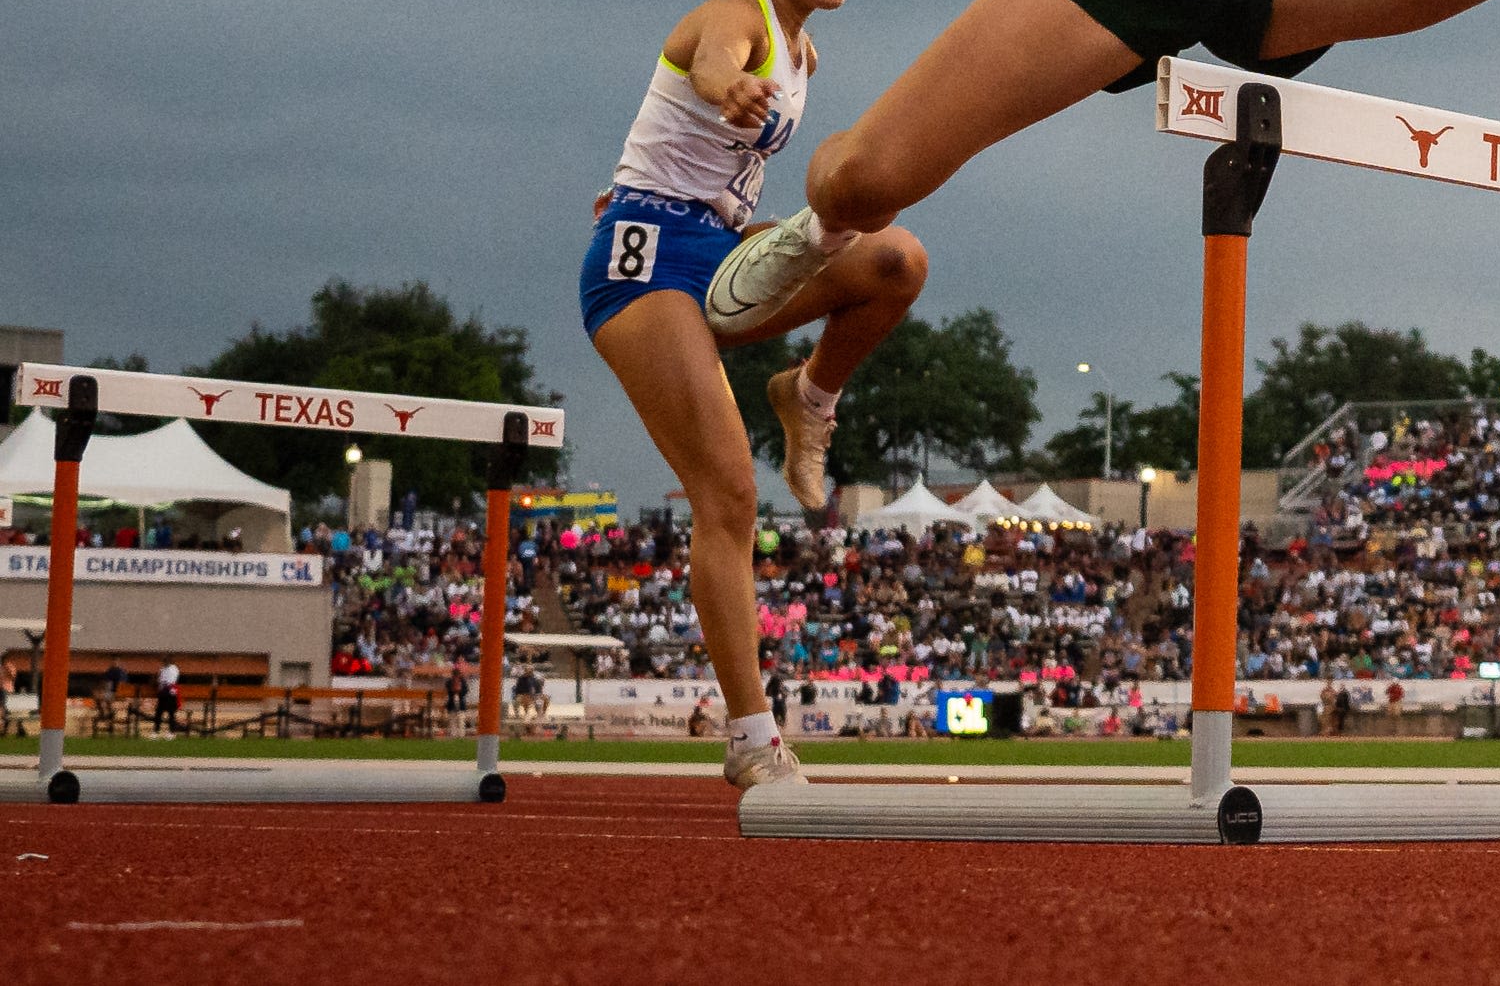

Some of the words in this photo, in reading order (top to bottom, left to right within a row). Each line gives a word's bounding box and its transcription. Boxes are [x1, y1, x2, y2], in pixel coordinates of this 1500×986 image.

[1181, 84, 1224, 123] XII
[617, 225, 648, 278] 8
[33, 378, 63, 397] XII
[255, 393, 354, 428] TEXAS
[531, 420, 556, 436] XII
[8, 554, 49, 571] STA
[86, 556, 268, 577] CHAMPIONSHIPS
